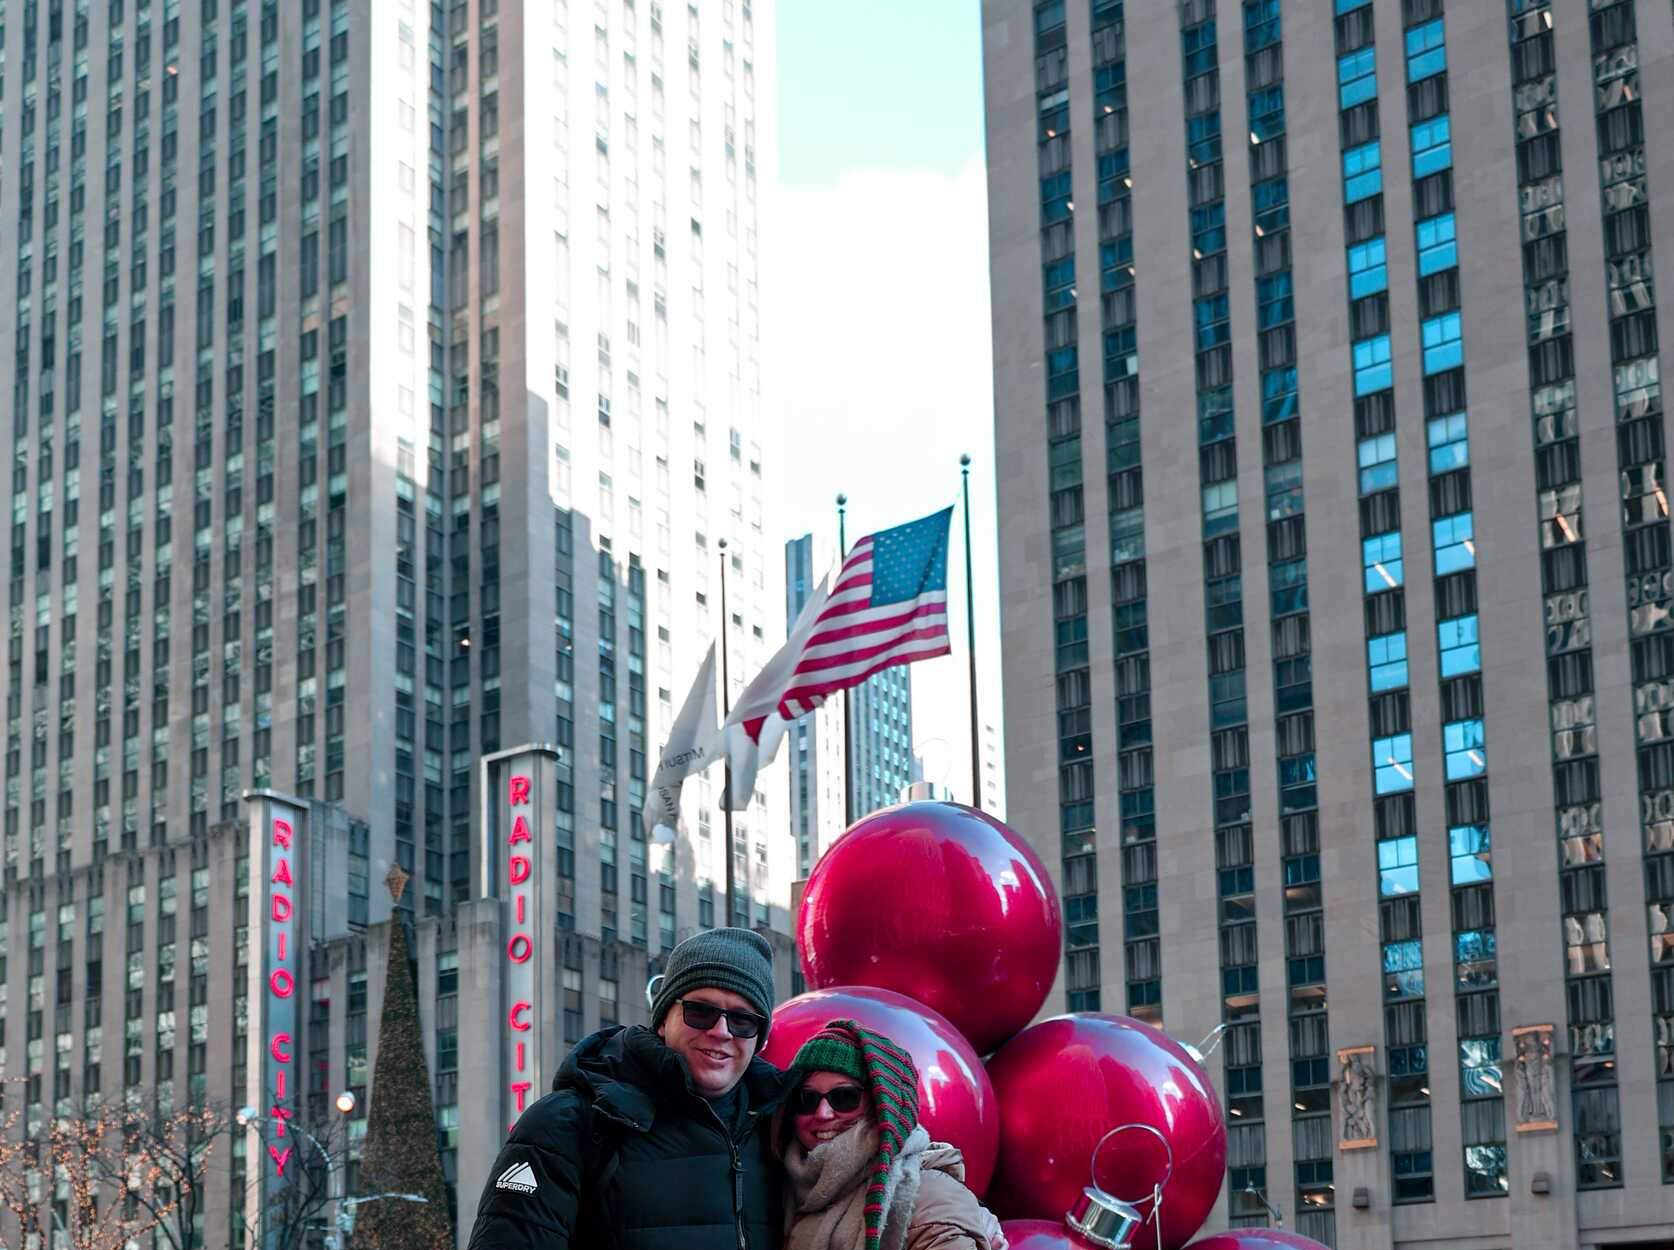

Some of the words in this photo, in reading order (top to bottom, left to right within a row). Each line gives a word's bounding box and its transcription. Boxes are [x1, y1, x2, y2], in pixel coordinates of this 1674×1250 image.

[269, 816, 295, 998] RADIO
[508, 774, 533, 964] RADIO
[268, 1031, 293, 1178] CITY
[509, 1000, 532, 1132] CIT
[495, 1181, 537, 1194] SUPERDRY
